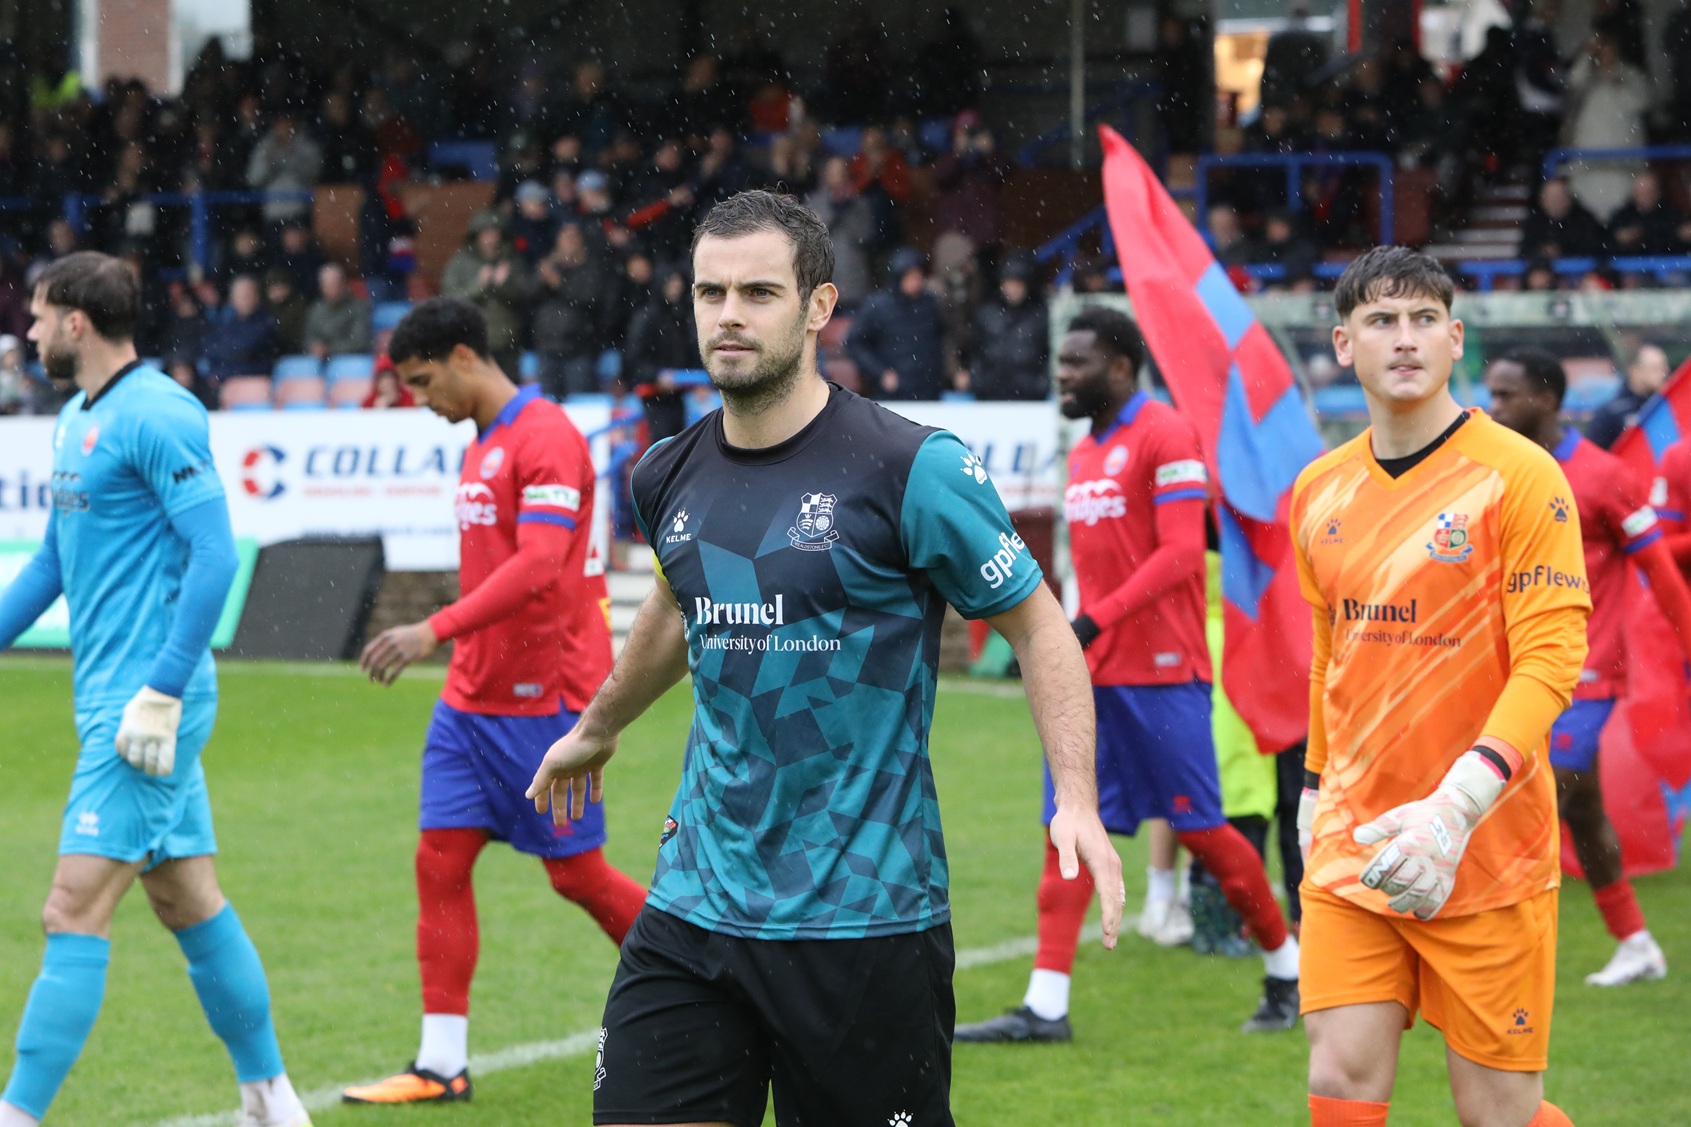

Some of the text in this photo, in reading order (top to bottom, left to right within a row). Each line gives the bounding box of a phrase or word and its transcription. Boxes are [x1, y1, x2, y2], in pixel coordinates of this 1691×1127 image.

[665, 533, 692, 544] KELME
[695, 594, 784, 625] Brunel
[1343, 598, 1417, 623] Brunel
[700, 634, 841, 655] University of London
[1346, 629, 1461, 648] Uersity of London
